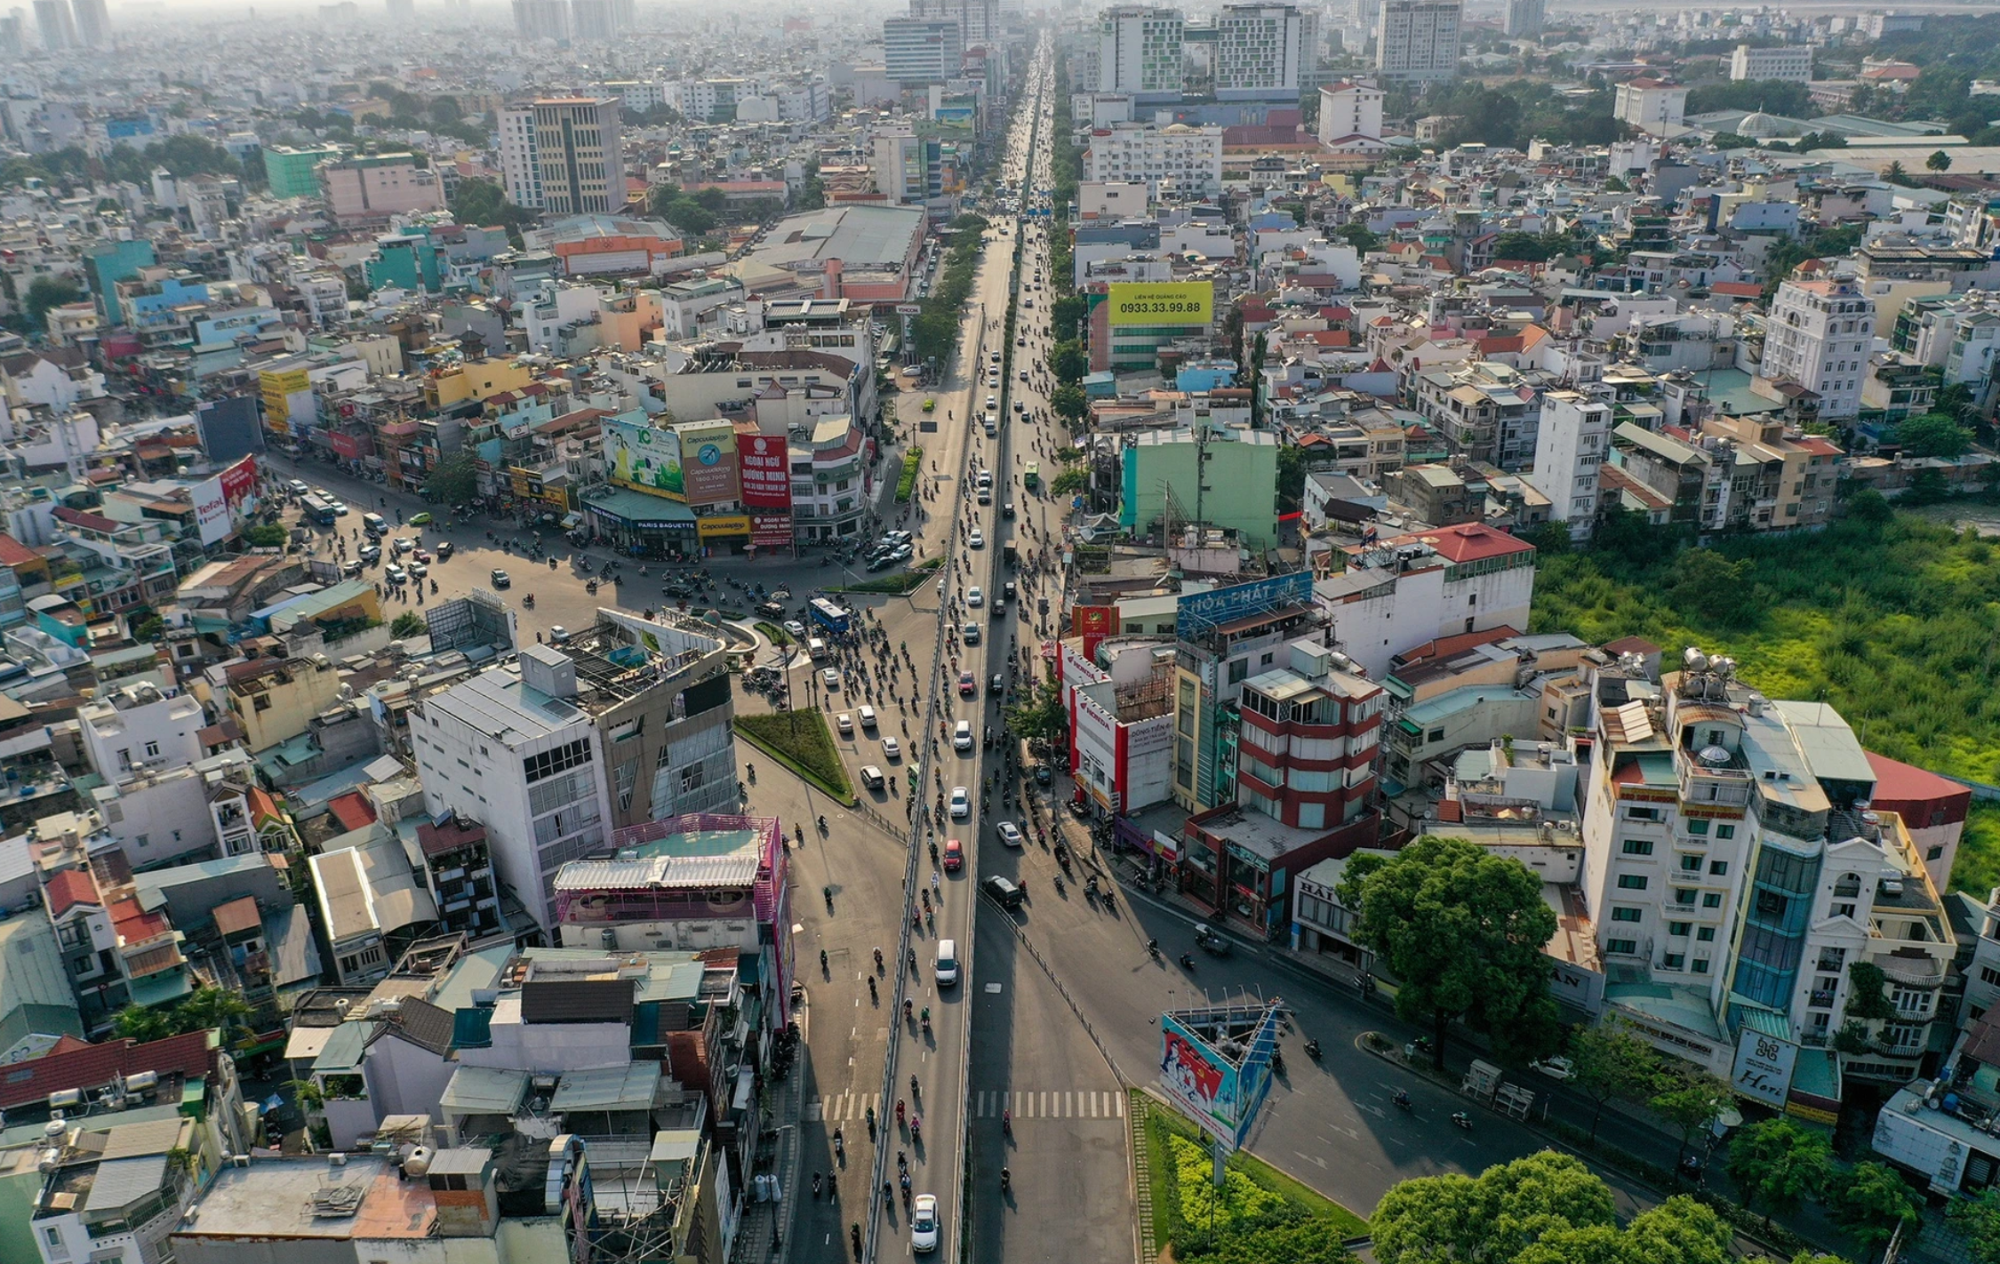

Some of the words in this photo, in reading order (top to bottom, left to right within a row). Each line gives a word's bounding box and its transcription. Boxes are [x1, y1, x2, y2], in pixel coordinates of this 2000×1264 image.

[1120, 302, 1201, 313] 0933.33.99.88
[197, 497, 224, 515] Tefal
[701, 520, 745, 531] Capcuulaptop
[1191, 595, 1226, 613] HÒA
[1231, 584, 1270, 605] PHÁT
[1073, 660, 1095, 679] HONDA
[1086, 707, 1111, 731] HONDA
